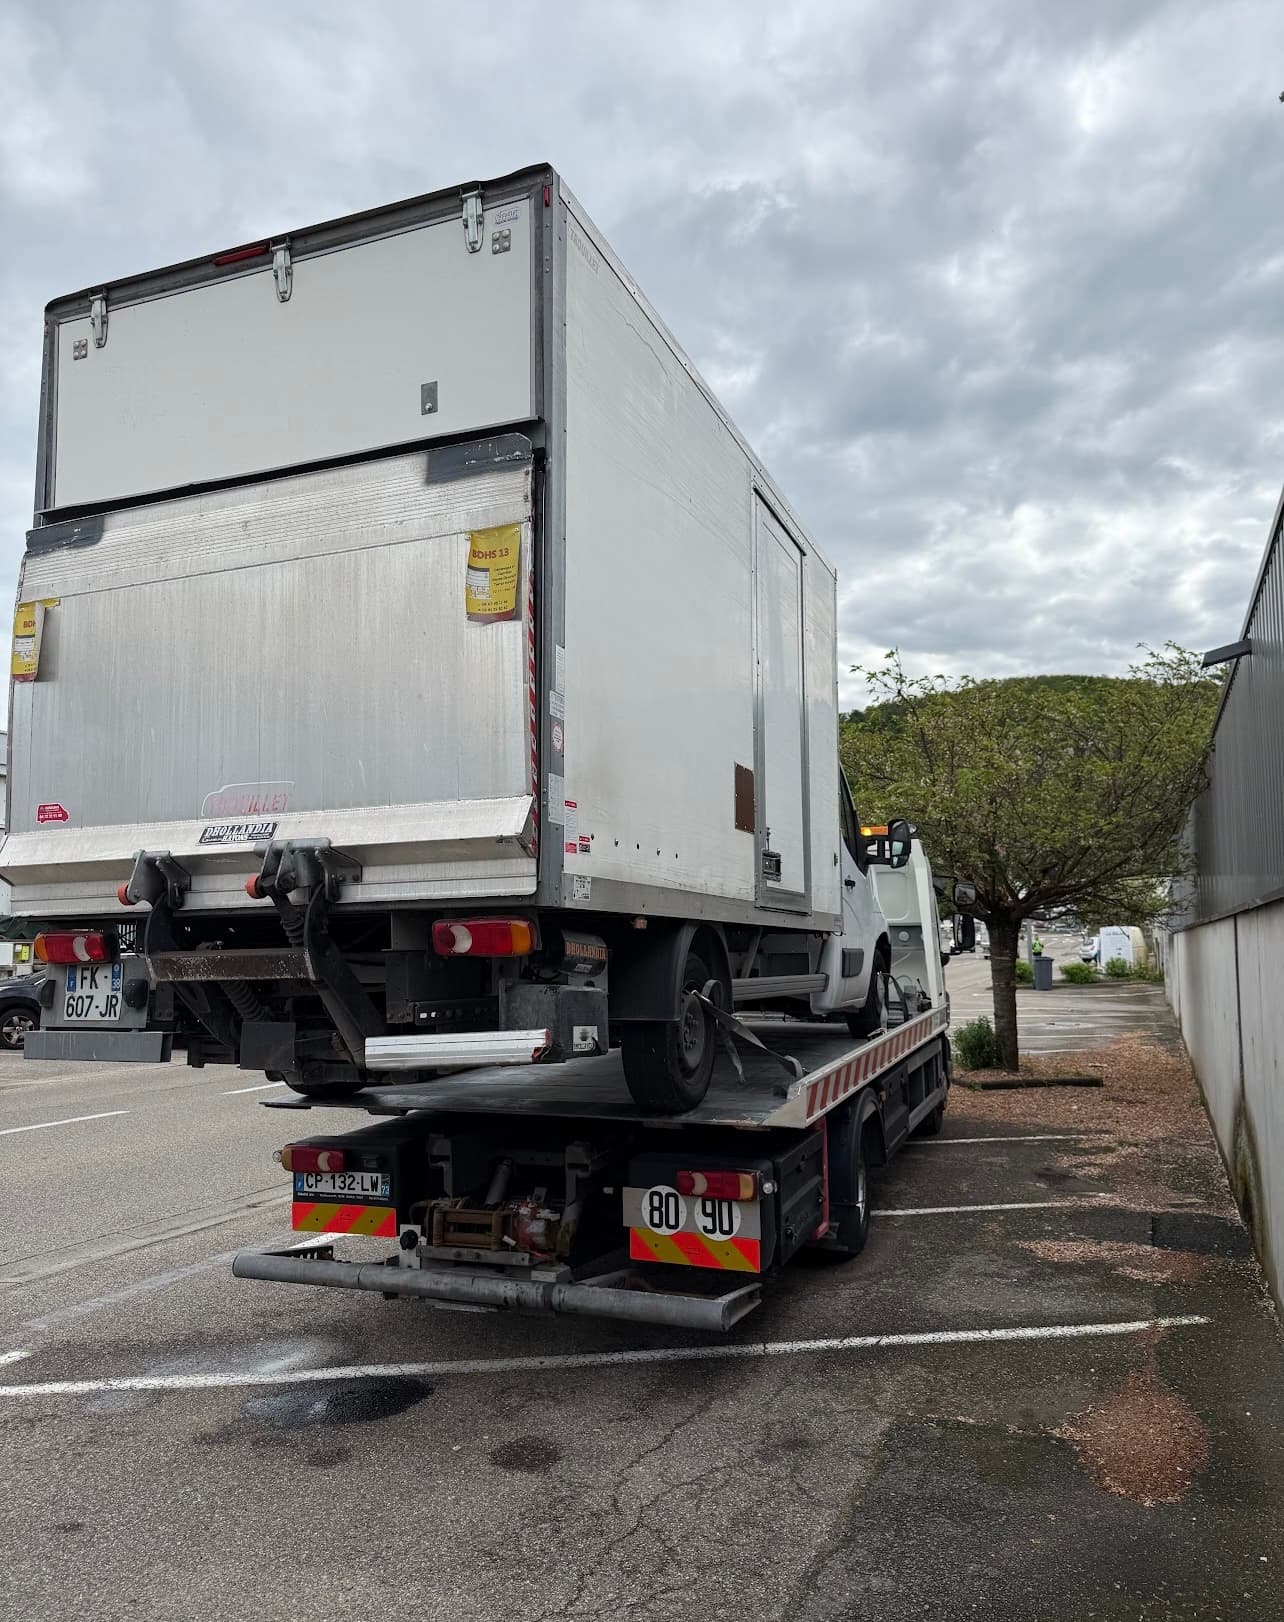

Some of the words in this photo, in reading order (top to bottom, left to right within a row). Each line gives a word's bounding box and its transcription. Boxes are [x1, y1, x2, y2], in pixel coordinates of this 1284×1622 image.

[472, 548, 497, 560] BDHS
[499, 547, 509, 557] 13
[204, 823, 274, 836] DHOLLANDIA
[112, 978, 120, 989] 38
[66, 994, 119, 1018] 607-JR
[305, 1172, 379, 1193] CP-132-LW
[381, 1184, 390, 1195] 73
[648, 1190, 680, 1230] 80
[701, 1199, 734, 1236] 90
